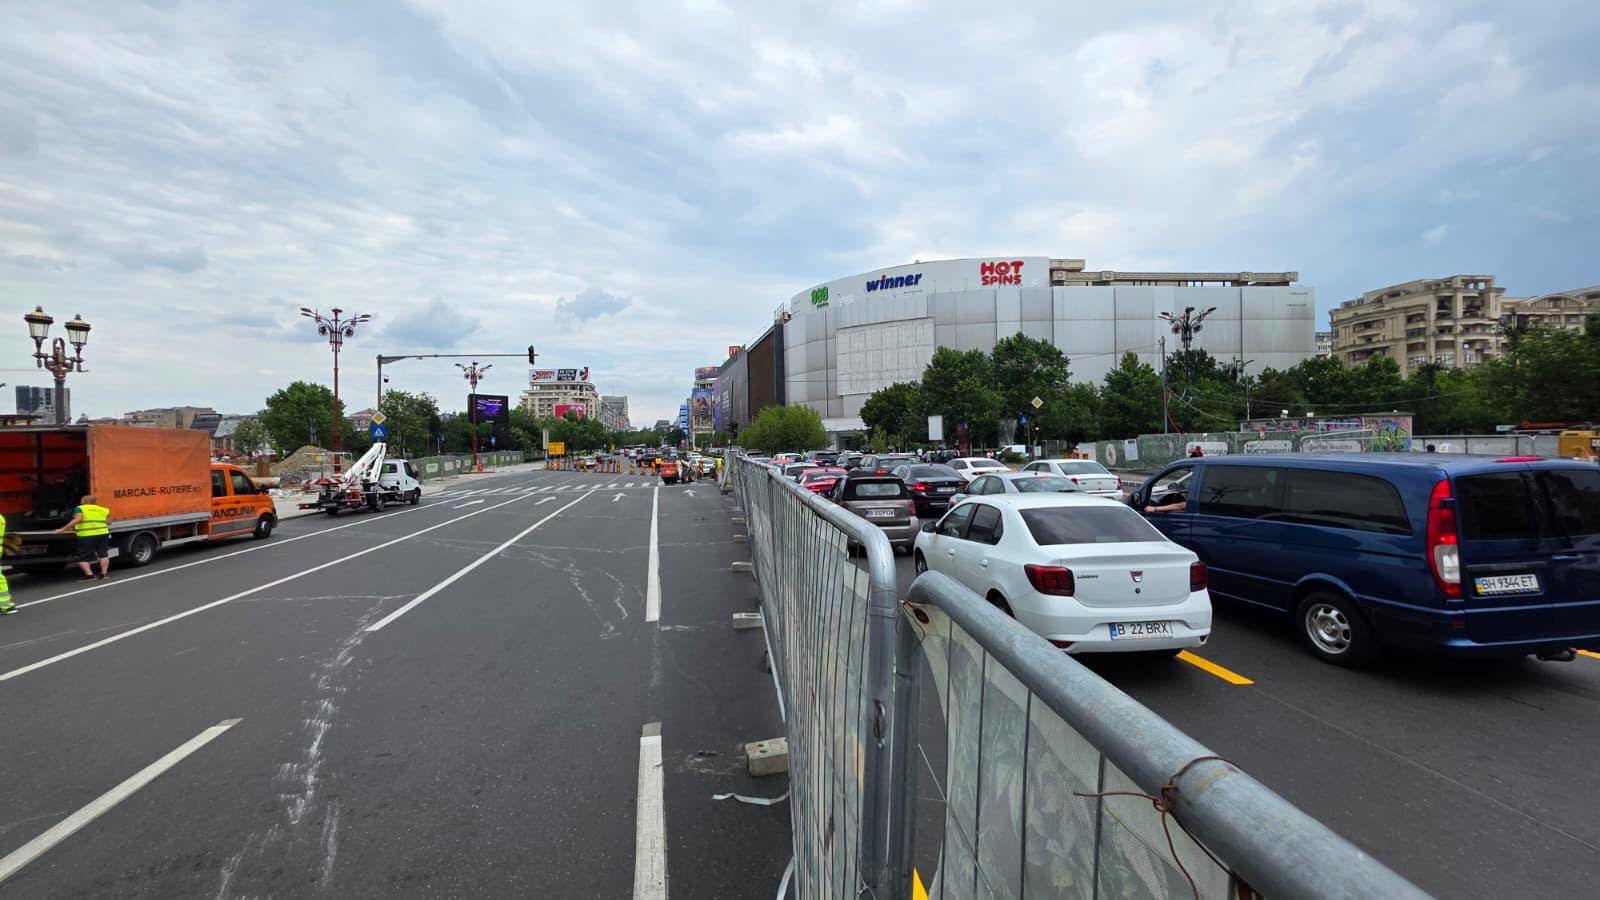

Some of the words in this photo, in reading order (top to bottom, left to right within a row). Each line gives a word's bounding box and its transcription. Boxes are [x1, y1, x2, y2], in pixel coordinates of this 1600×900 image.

[980, 261, 1025, 275] HOT
[866, 273, 922, 292] winner
[981, 274, 1022, 286] SPINS
[1481, 578, 1497, 589] BH
[1497, 577, 1520, 588] 9344
[1520, 575, 1534, 587] ET
[1117, 624, 1126, 636] B
[1131, 623, 1144, 635] 22
[1146, 622, 1169, 634] BRX
